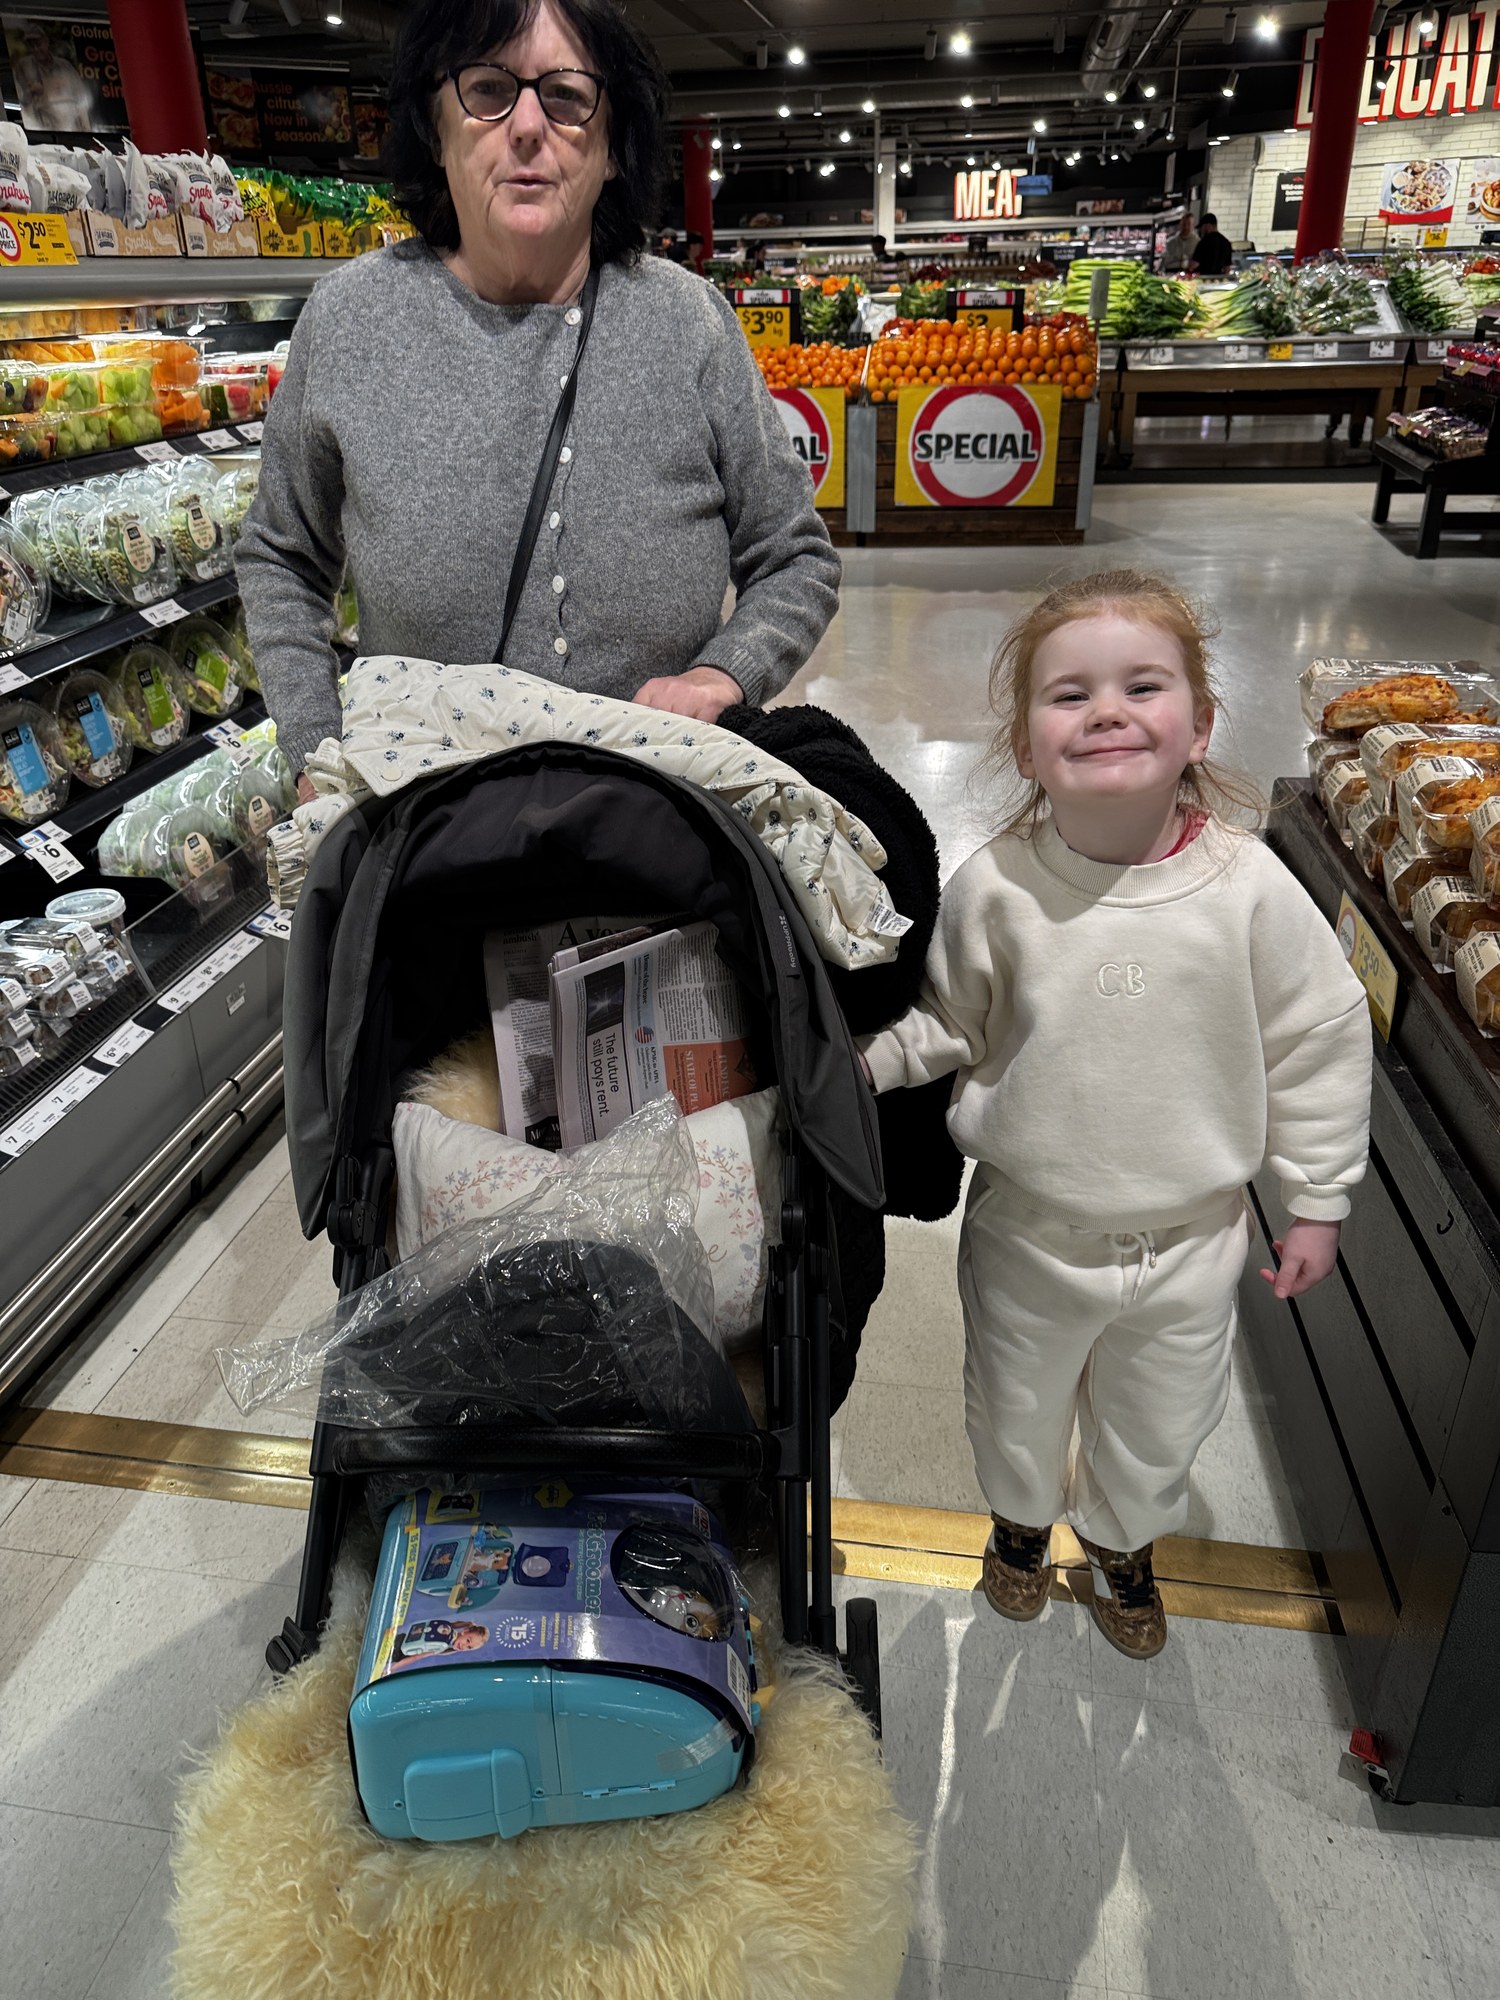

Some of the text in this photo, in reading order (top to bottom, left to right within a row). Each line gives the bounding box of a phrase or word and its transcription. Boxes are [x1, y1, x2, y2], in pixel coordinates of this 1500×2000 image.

[79, 63, 101, 80] for
[263, 113, 308, 127] Now in
[955, 169, 1027, 219] MEAT
[916, 433, 1036, 460] SPECIAL
[559, 921, 579, 945] A
[1097, 963, 1146, 998] CB
[605, 1033, 619, 1093] The future
[685, 1050, 697, 1079] STATE
[590, 1038, 610, 1118] still pays rent.
[688, 1079, 698, 1092] OF
[511, 1623, 528, 1641] 15
